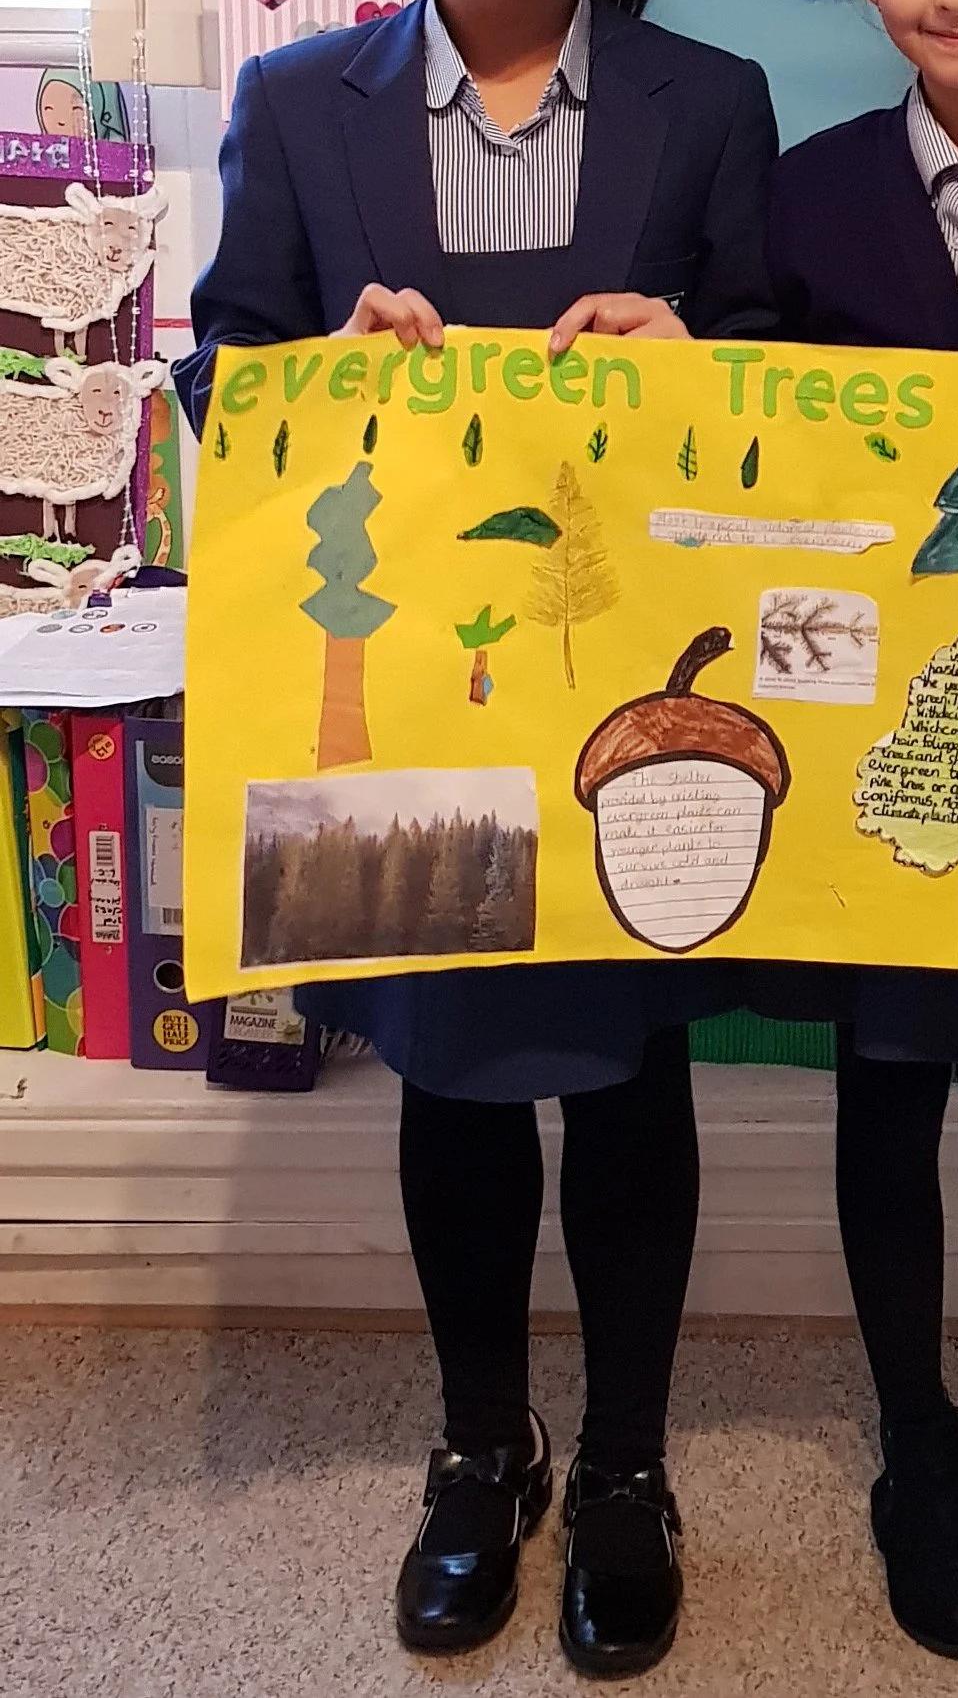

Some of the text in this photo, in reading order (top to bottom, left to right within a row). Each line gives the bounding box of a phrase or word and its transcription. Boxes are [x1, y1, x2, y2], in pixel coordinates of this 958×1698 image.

[221, 341, 936, 429] evergreen Trees
[914, 750, 943, 764] and
[868, 758, 940, 779] evergreen
[931, 783, 947, 793] or
[162, 1015, 182, 1023] BUY
[230, 1015, 277, 1029] MAGAZINE
[162, 1023, 182, 1031] GET
